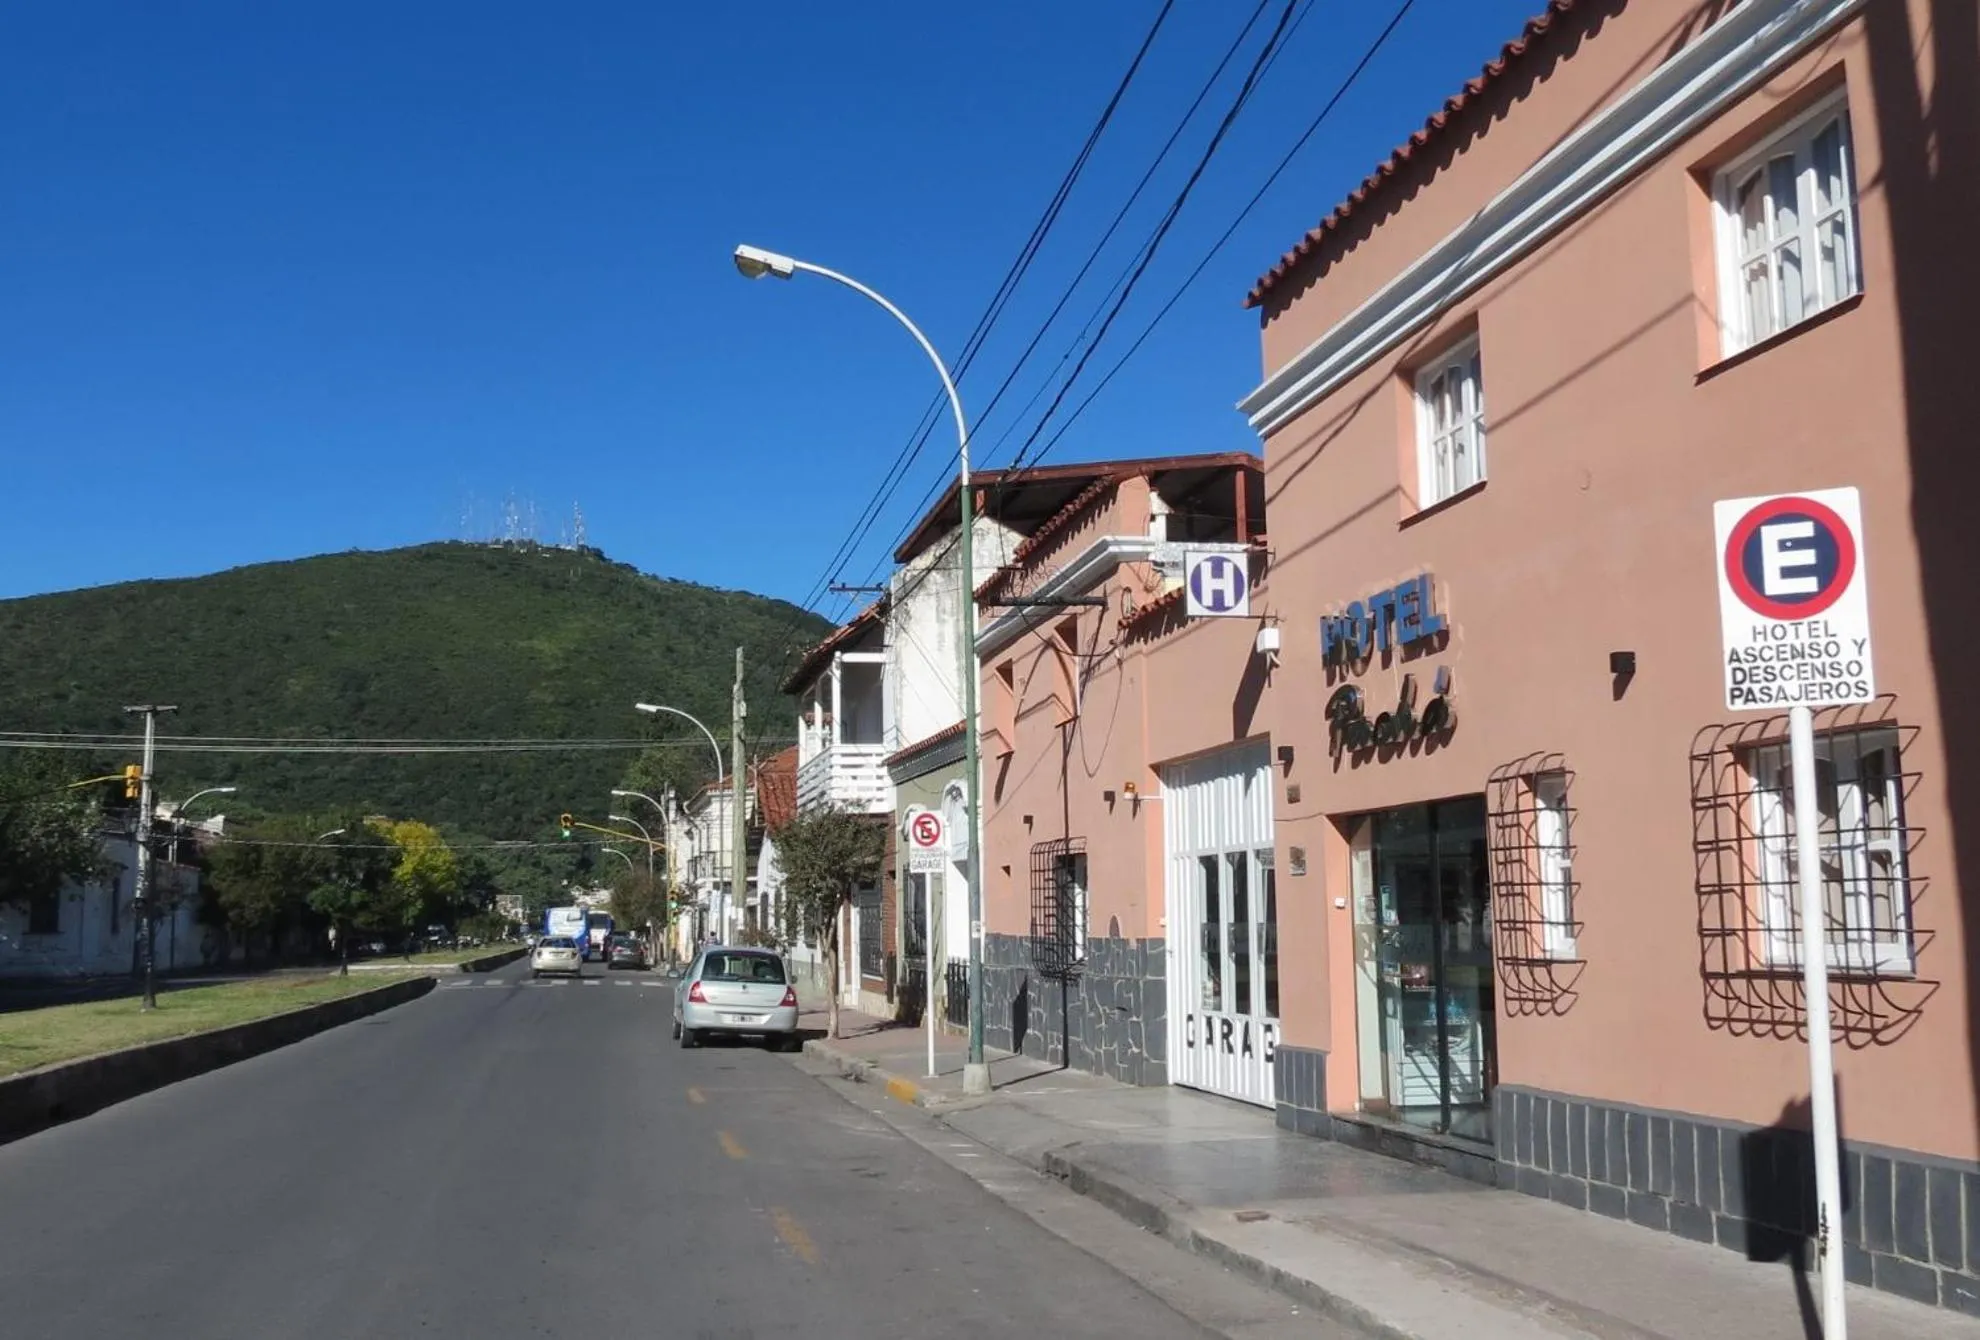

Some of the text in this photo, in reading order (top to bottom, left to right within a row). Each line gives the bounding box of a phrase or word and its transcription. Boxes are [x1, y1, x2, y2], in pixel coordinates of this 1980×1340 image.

[1760, 520, 1819, 596] E
[1201, 561, 1235, 607] H
[1320, 573, 1447, 661] HOTEL
[1752, 620, 1837, 643] HOTEL
[1727, 637, 1867, 666] ASCENSO Y
[1731, 659, 1863, 685] DESCENSO
[1729, 679, 1869, 706] PASAJEROS
